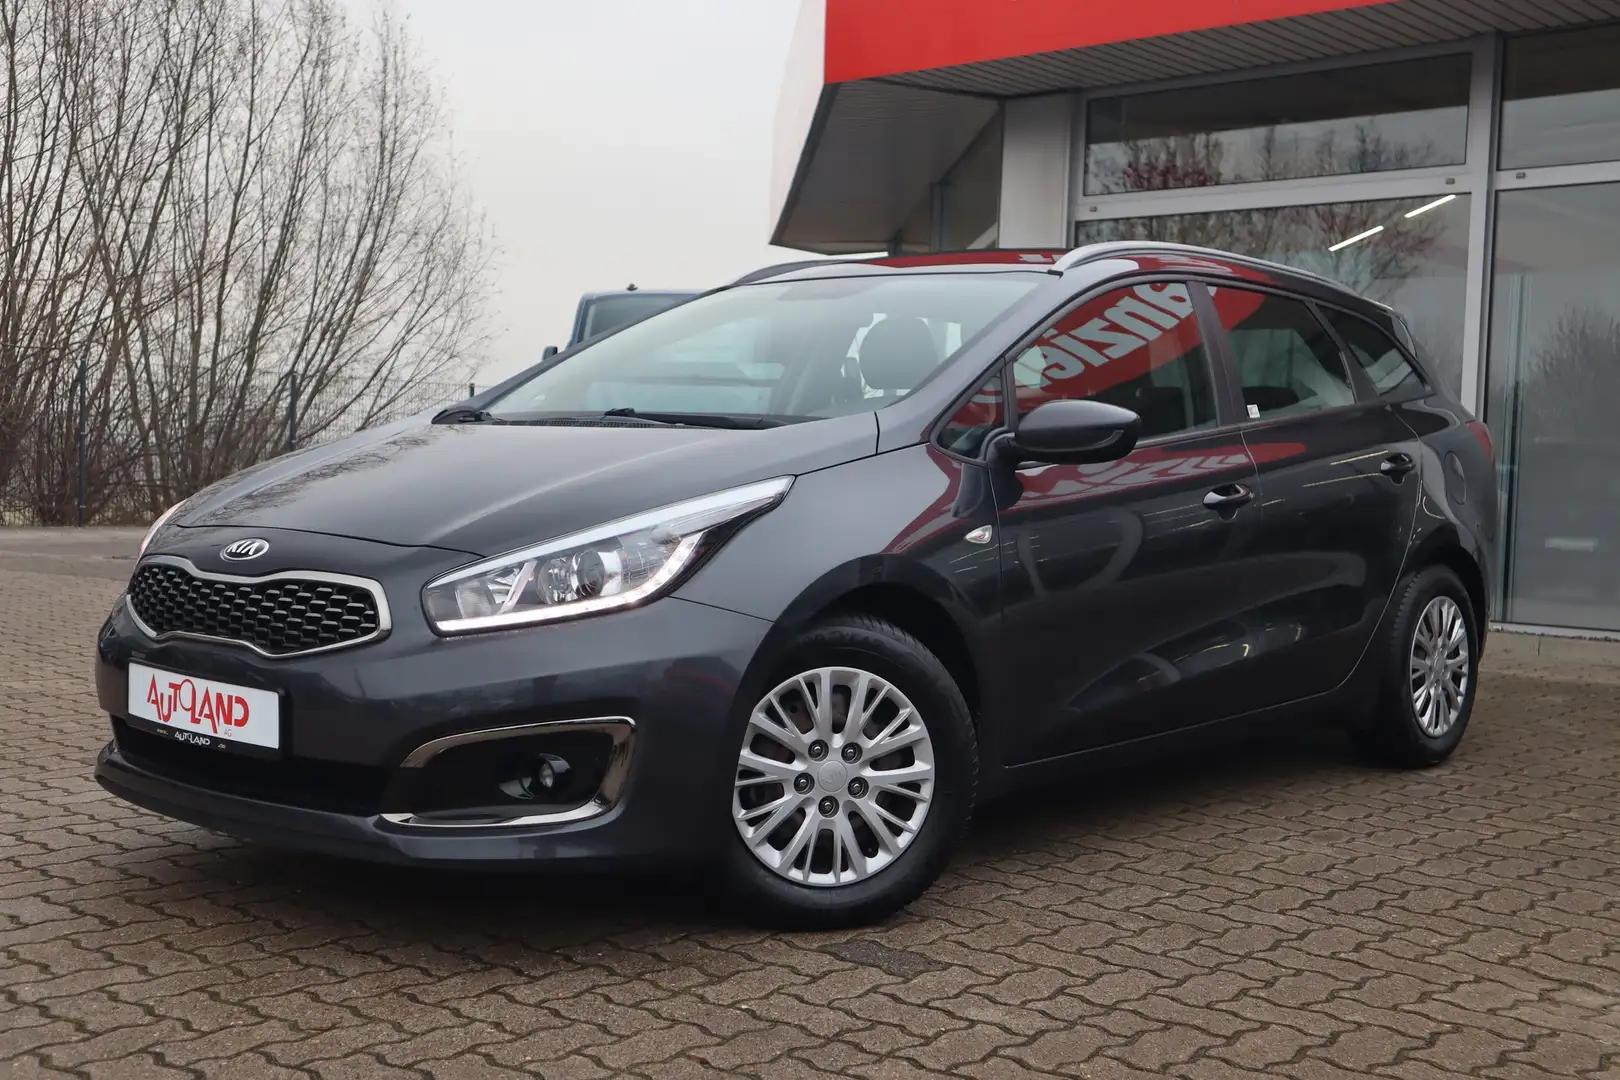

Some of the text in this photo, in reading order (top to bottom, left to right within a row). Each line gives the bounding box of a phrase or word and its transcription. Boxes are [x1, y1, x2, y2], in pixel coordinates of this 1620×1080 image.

[226, 539, 260, 555] KIA
[146, 673, 250, 735] AUTOLAND
[174, 731, 211, 746] AUTOLAND
[224, 728, 233, 738] AG
